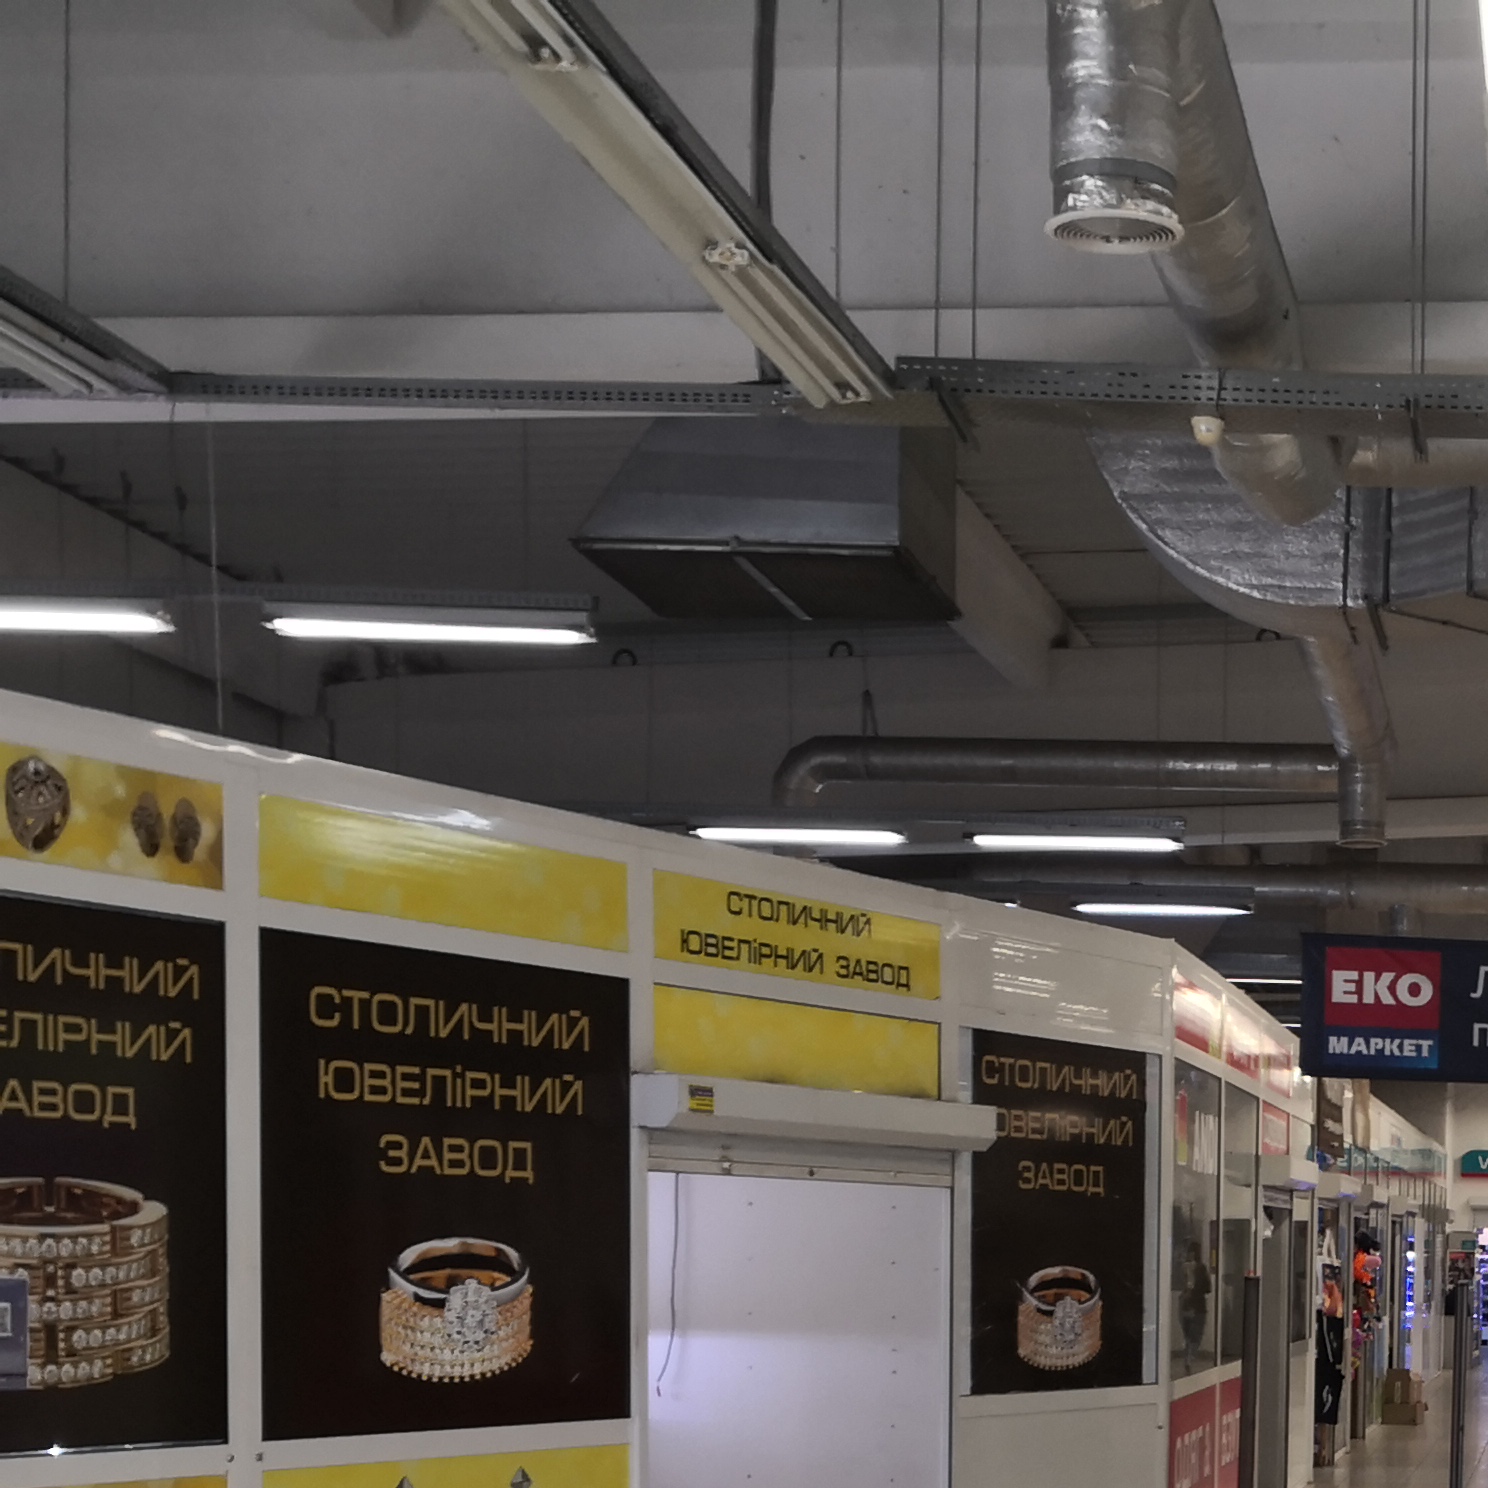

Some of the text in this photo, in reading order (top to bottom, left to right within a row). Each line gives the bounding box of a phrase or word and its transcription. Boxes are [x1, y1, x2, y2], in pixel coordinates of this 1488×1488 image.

[726, 890, 873, 938] СТОЛИЧНИЙ
[0, 940, 200, 1000] ЛИЧНИЙ
[835, 955, 911, 991] ЗАВОД
[1331, 969, 1434, 1007] ЕКО
[308, 985, 590, 1053] СТОЛИЧНИЙ
[1327, 1035, 1434, 1058] МАРКЕТ
[981, 1054, 1138, 1100] СТОЛИЧНИЙ
[0, 1077, 137, 1131] АВОД
[378, 1133, 535, 1185] ЗАВОД
[1018, 1160, 1105, 1197] ЗАВОД
